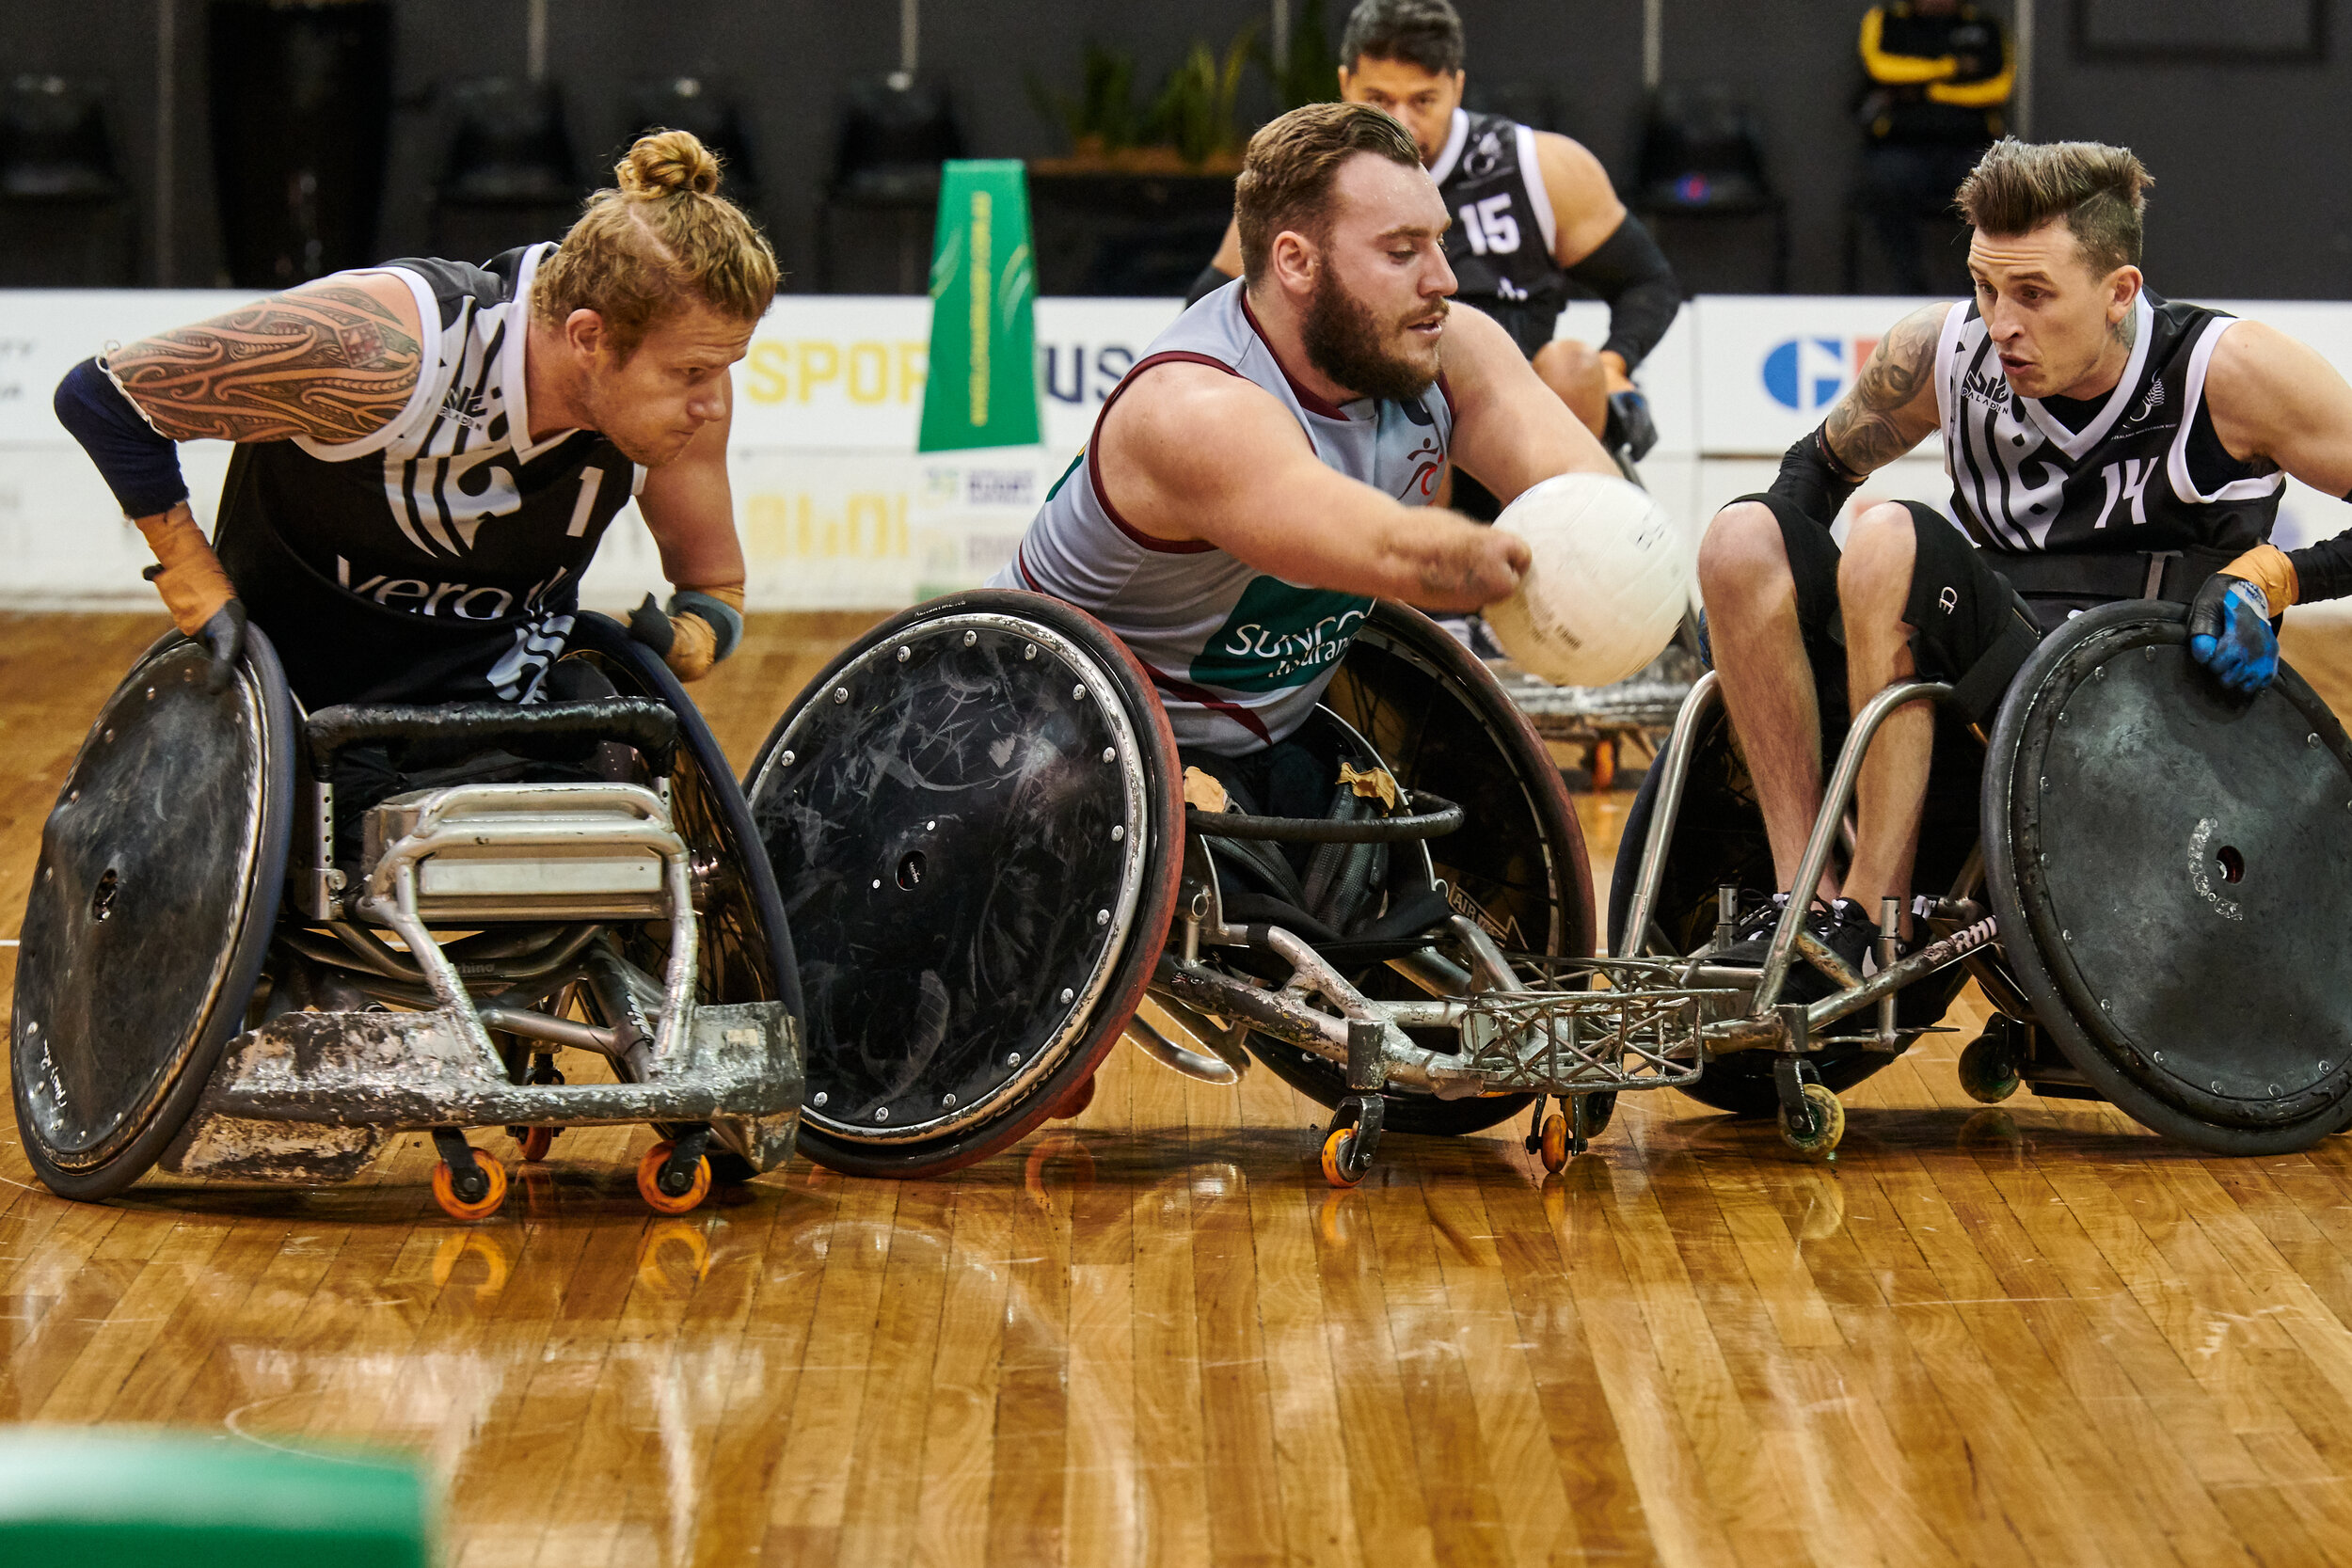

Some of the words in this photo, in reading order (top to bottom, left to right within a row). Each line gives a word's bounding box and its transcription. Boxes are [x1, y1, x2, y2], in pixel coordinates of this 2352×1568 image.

[1459, 193, 1521, 255] 15
[1962, 387, 2010, 415] PALADIN
[565, 466, 605, 538] 1
[2094, 456, 2160, 530] 14
[1949, 913, 1998, 955] RHI
